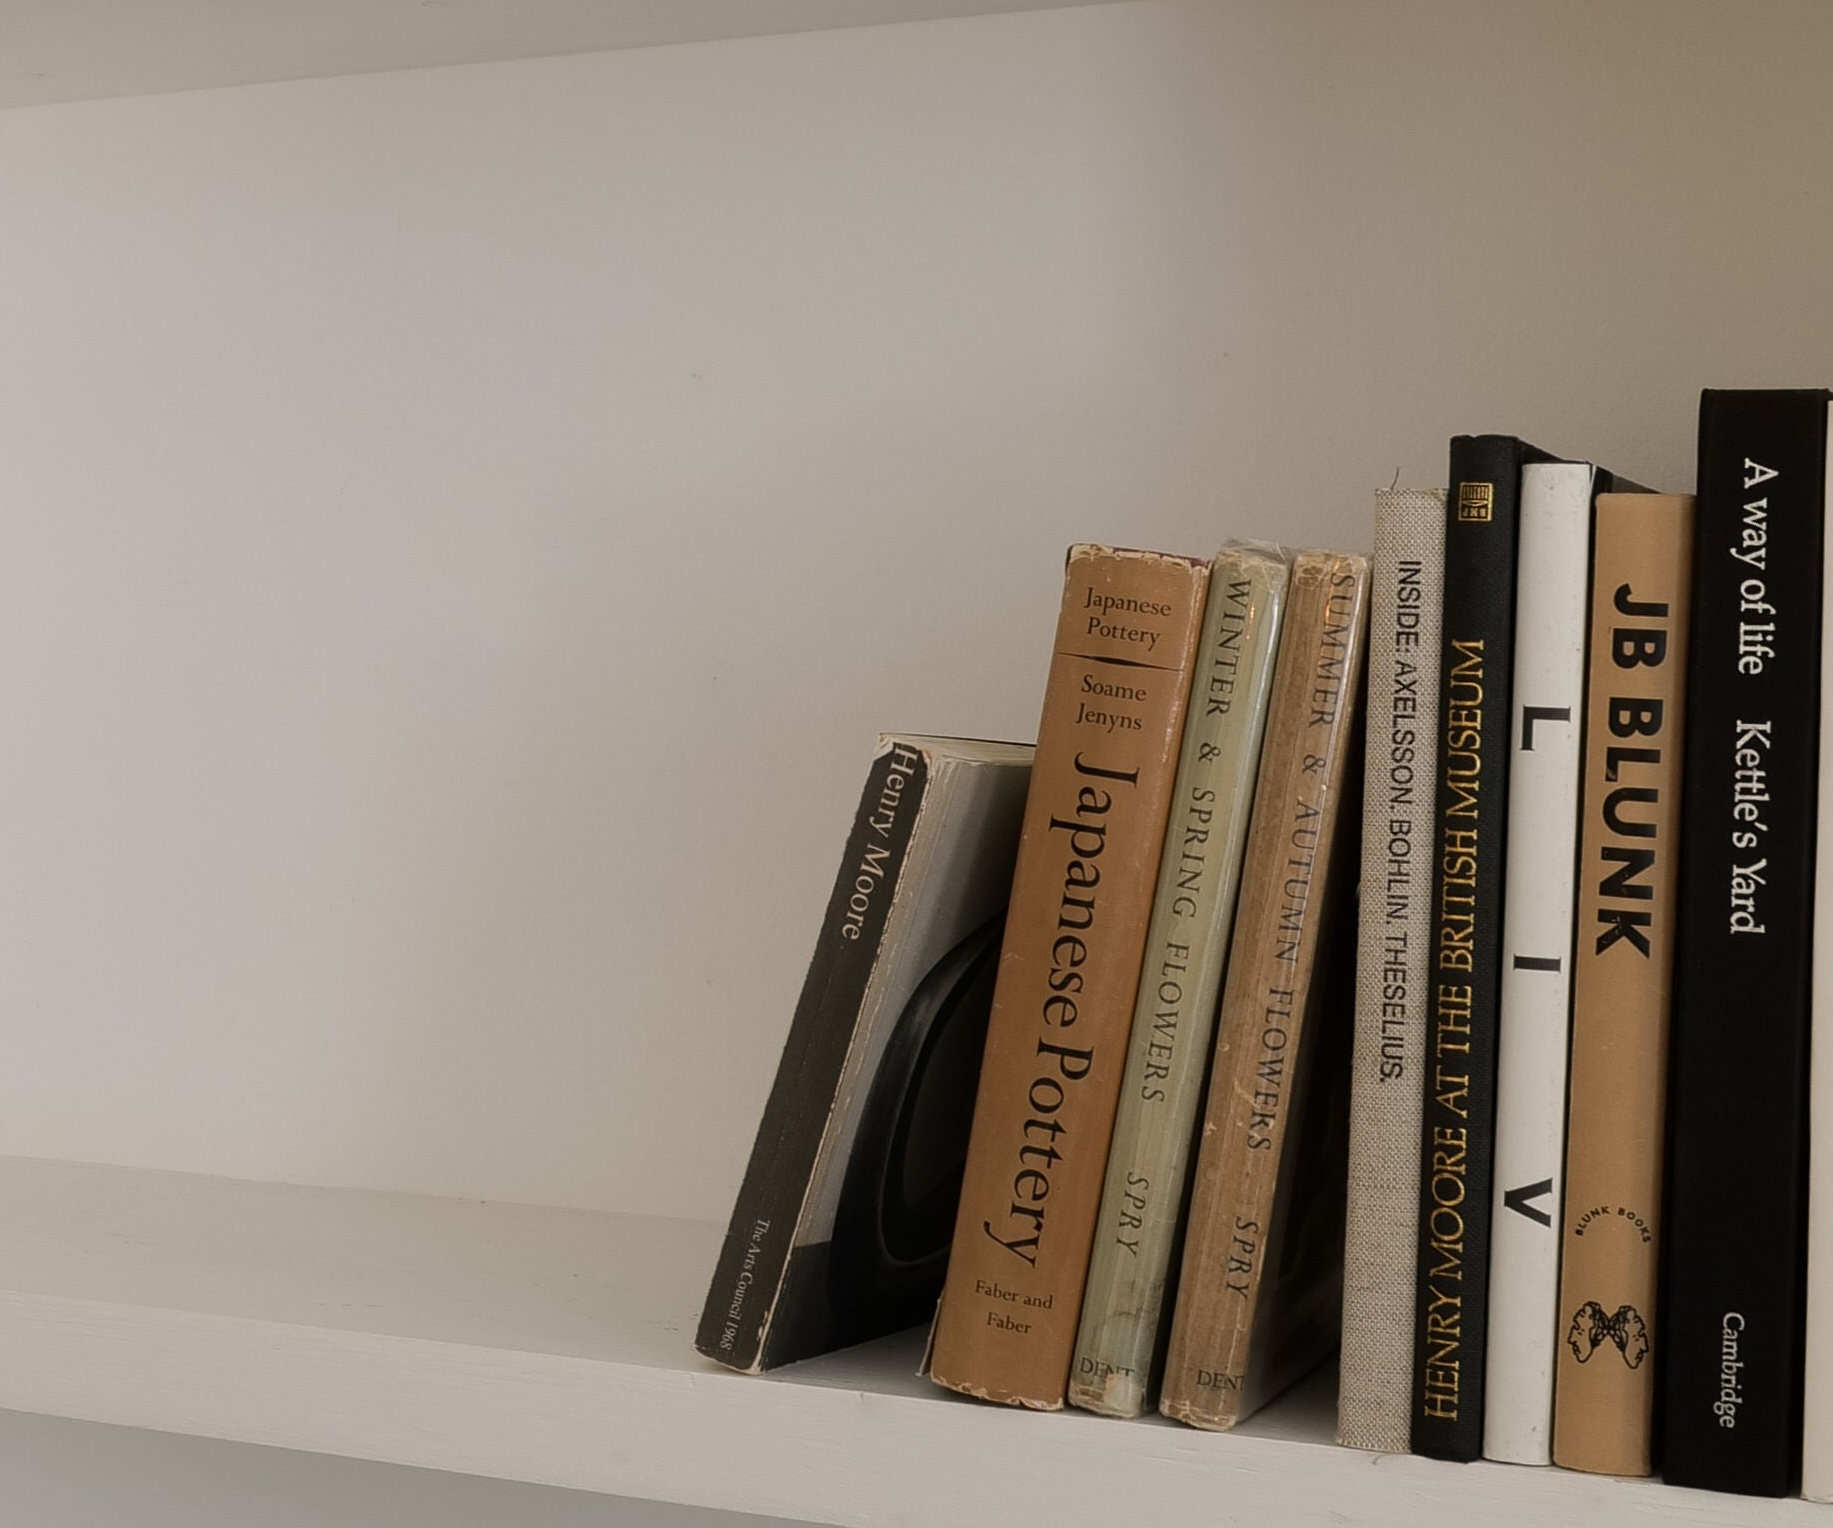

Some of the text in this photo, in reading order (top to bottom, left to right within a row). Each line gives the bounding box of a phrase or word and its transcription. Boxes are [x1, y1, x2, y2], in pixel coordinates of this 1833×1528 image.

[1083, 586, 1172, 617] Japanese
[1087, 618, 1161, 651] Pottery
[1074, 702, 1143, 733] Jenyns
[1081, 674, 1147, 702] Soame
[1729, 457, 1780, 934] A way of life Kettle's Yard
[1380, 560, 1422, 1083] INSIDE: AXELSSON. BOHLIN. THESELIUS.
[1594, 582, 1670, 961] JB BLUNK
[842, 746, 917, 941] Henry Moore
[1115, 578, 1252, 1257] WINTER & SPRING FLOWERS SPRY
[1228, 572, 1357, 1300] SUMMER & AUTUMN FLOWERS SPRY
[984, 752, 1141, 1268] Japanese Pottery
[1423, 638, 1485, 1422] HENRY MOORE AT THE BRITISH MUSEUM
[719, 1219, 770, 1350] The Arts Council 1968
[1575, 1205, 1652, 1243] BLUNK BOOKS
[974, 1279, 1054, 1311] Faber and
[986, 1311, 1033, 1335] Faber
[1713, 1310, 1746, 1429] Cambridge
